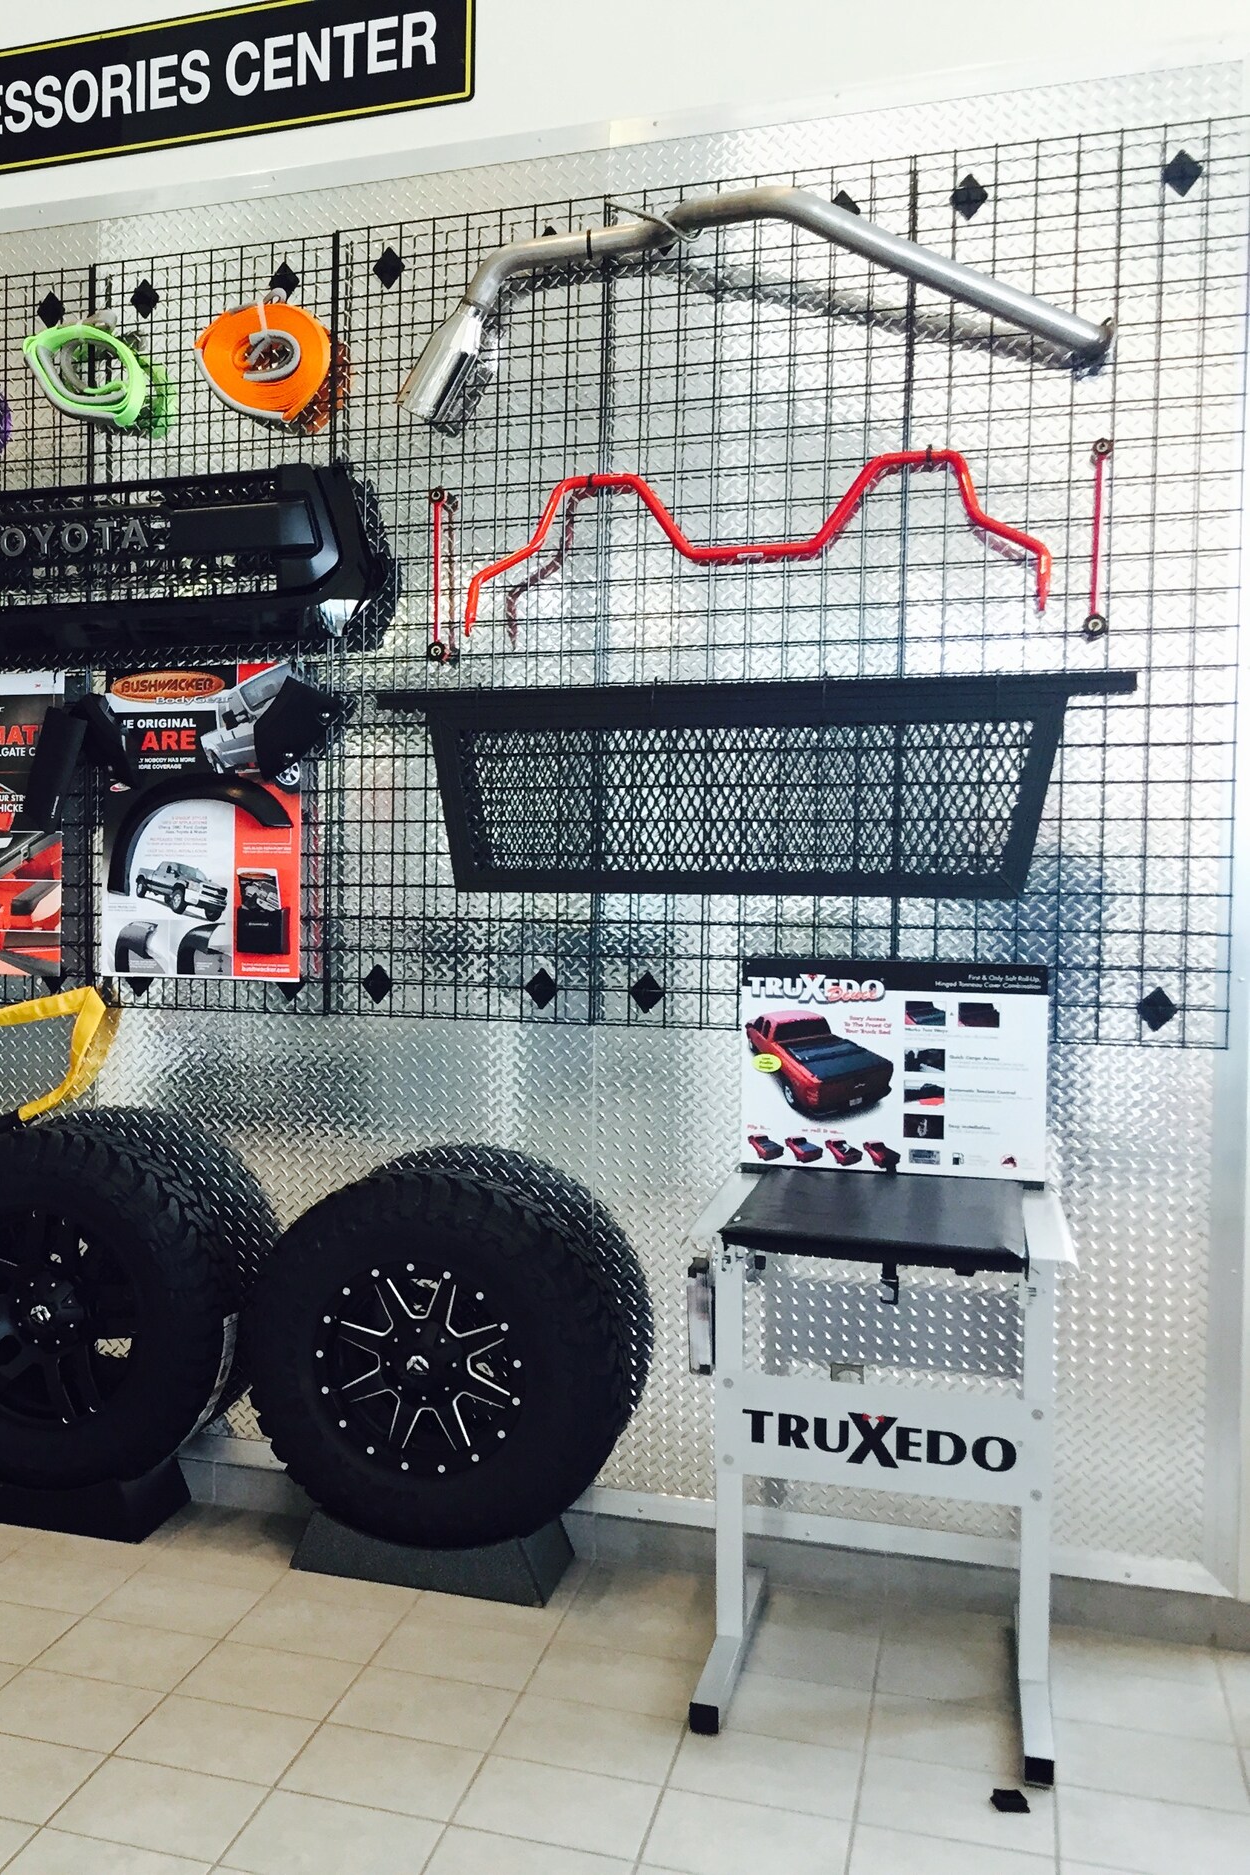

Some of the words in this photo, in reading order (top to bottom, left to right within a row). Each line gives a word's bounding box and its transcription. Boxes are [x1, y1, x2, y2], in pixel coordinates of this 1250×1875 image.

[226, 11, 438, 97] CENTER
[121, 677, 214, 693] BUSHWACKER
[155, 696, 233, 706] BodyGear
[137, 718, 197, 729] ORIGINAL
[141, 729, 197, 751] ARE
[28, 747, 36, 757] C
[11, 794, 26, 802] STR
[747, 973, 886, 1004] TRUXEDO
[742, 1408, 1017, 1473] TRUXEDO
